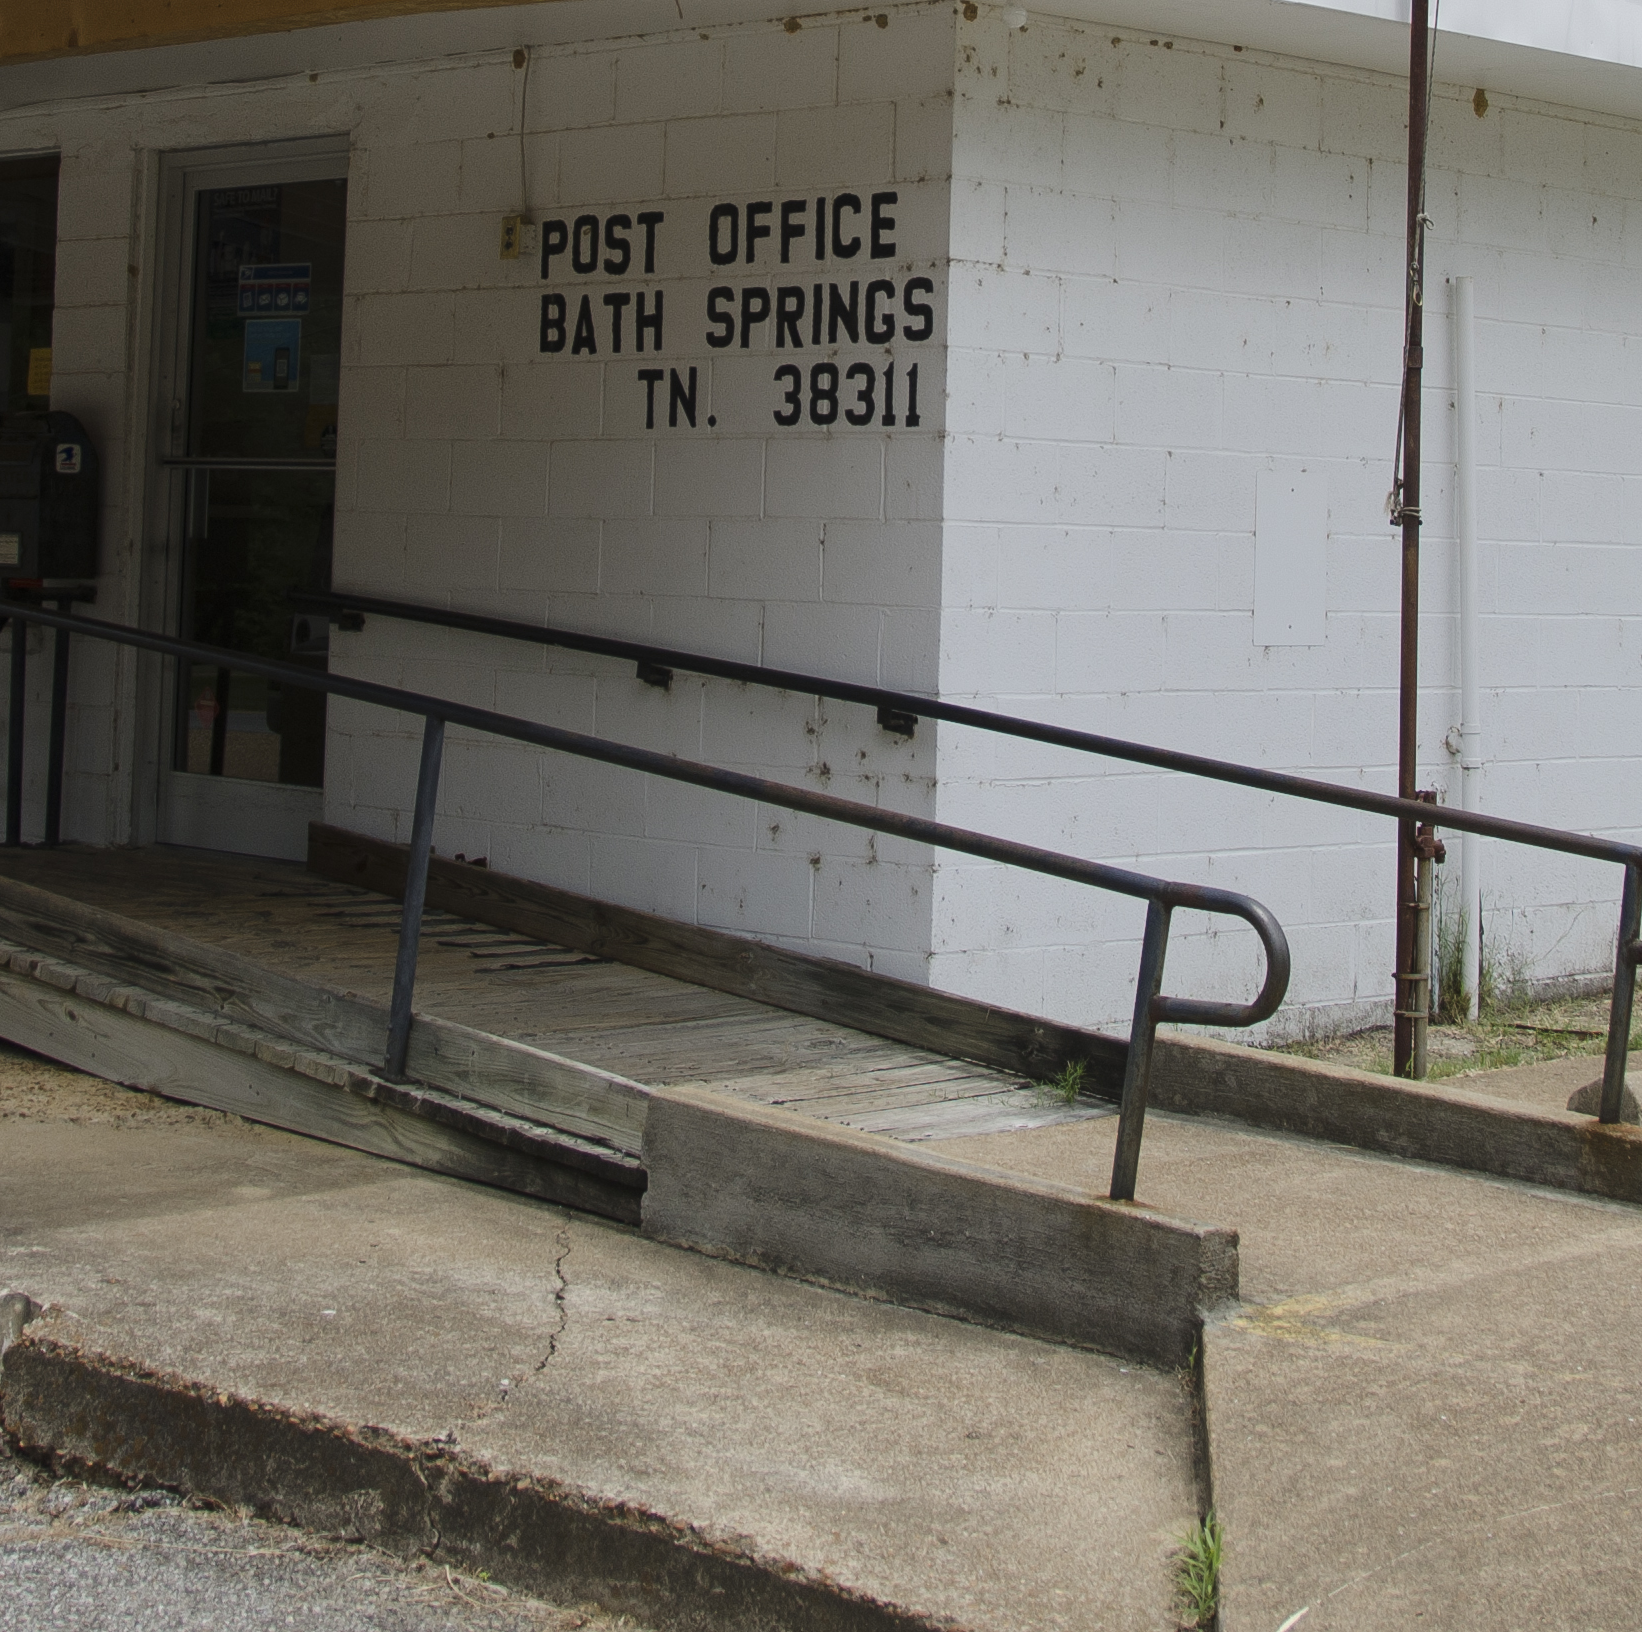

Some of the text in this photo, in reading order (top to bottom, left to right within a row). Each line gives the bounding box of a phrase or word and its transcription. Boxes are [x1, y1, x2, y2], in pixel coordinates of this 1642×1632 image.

[213, 187, 279, 206] SAFE TO MAIL?
[540, 191, 898, 279] POST OFFICE
[540, 277, 934, 354] BATH SPRINGS
[638, 361, 921, 429] TN. 38311
